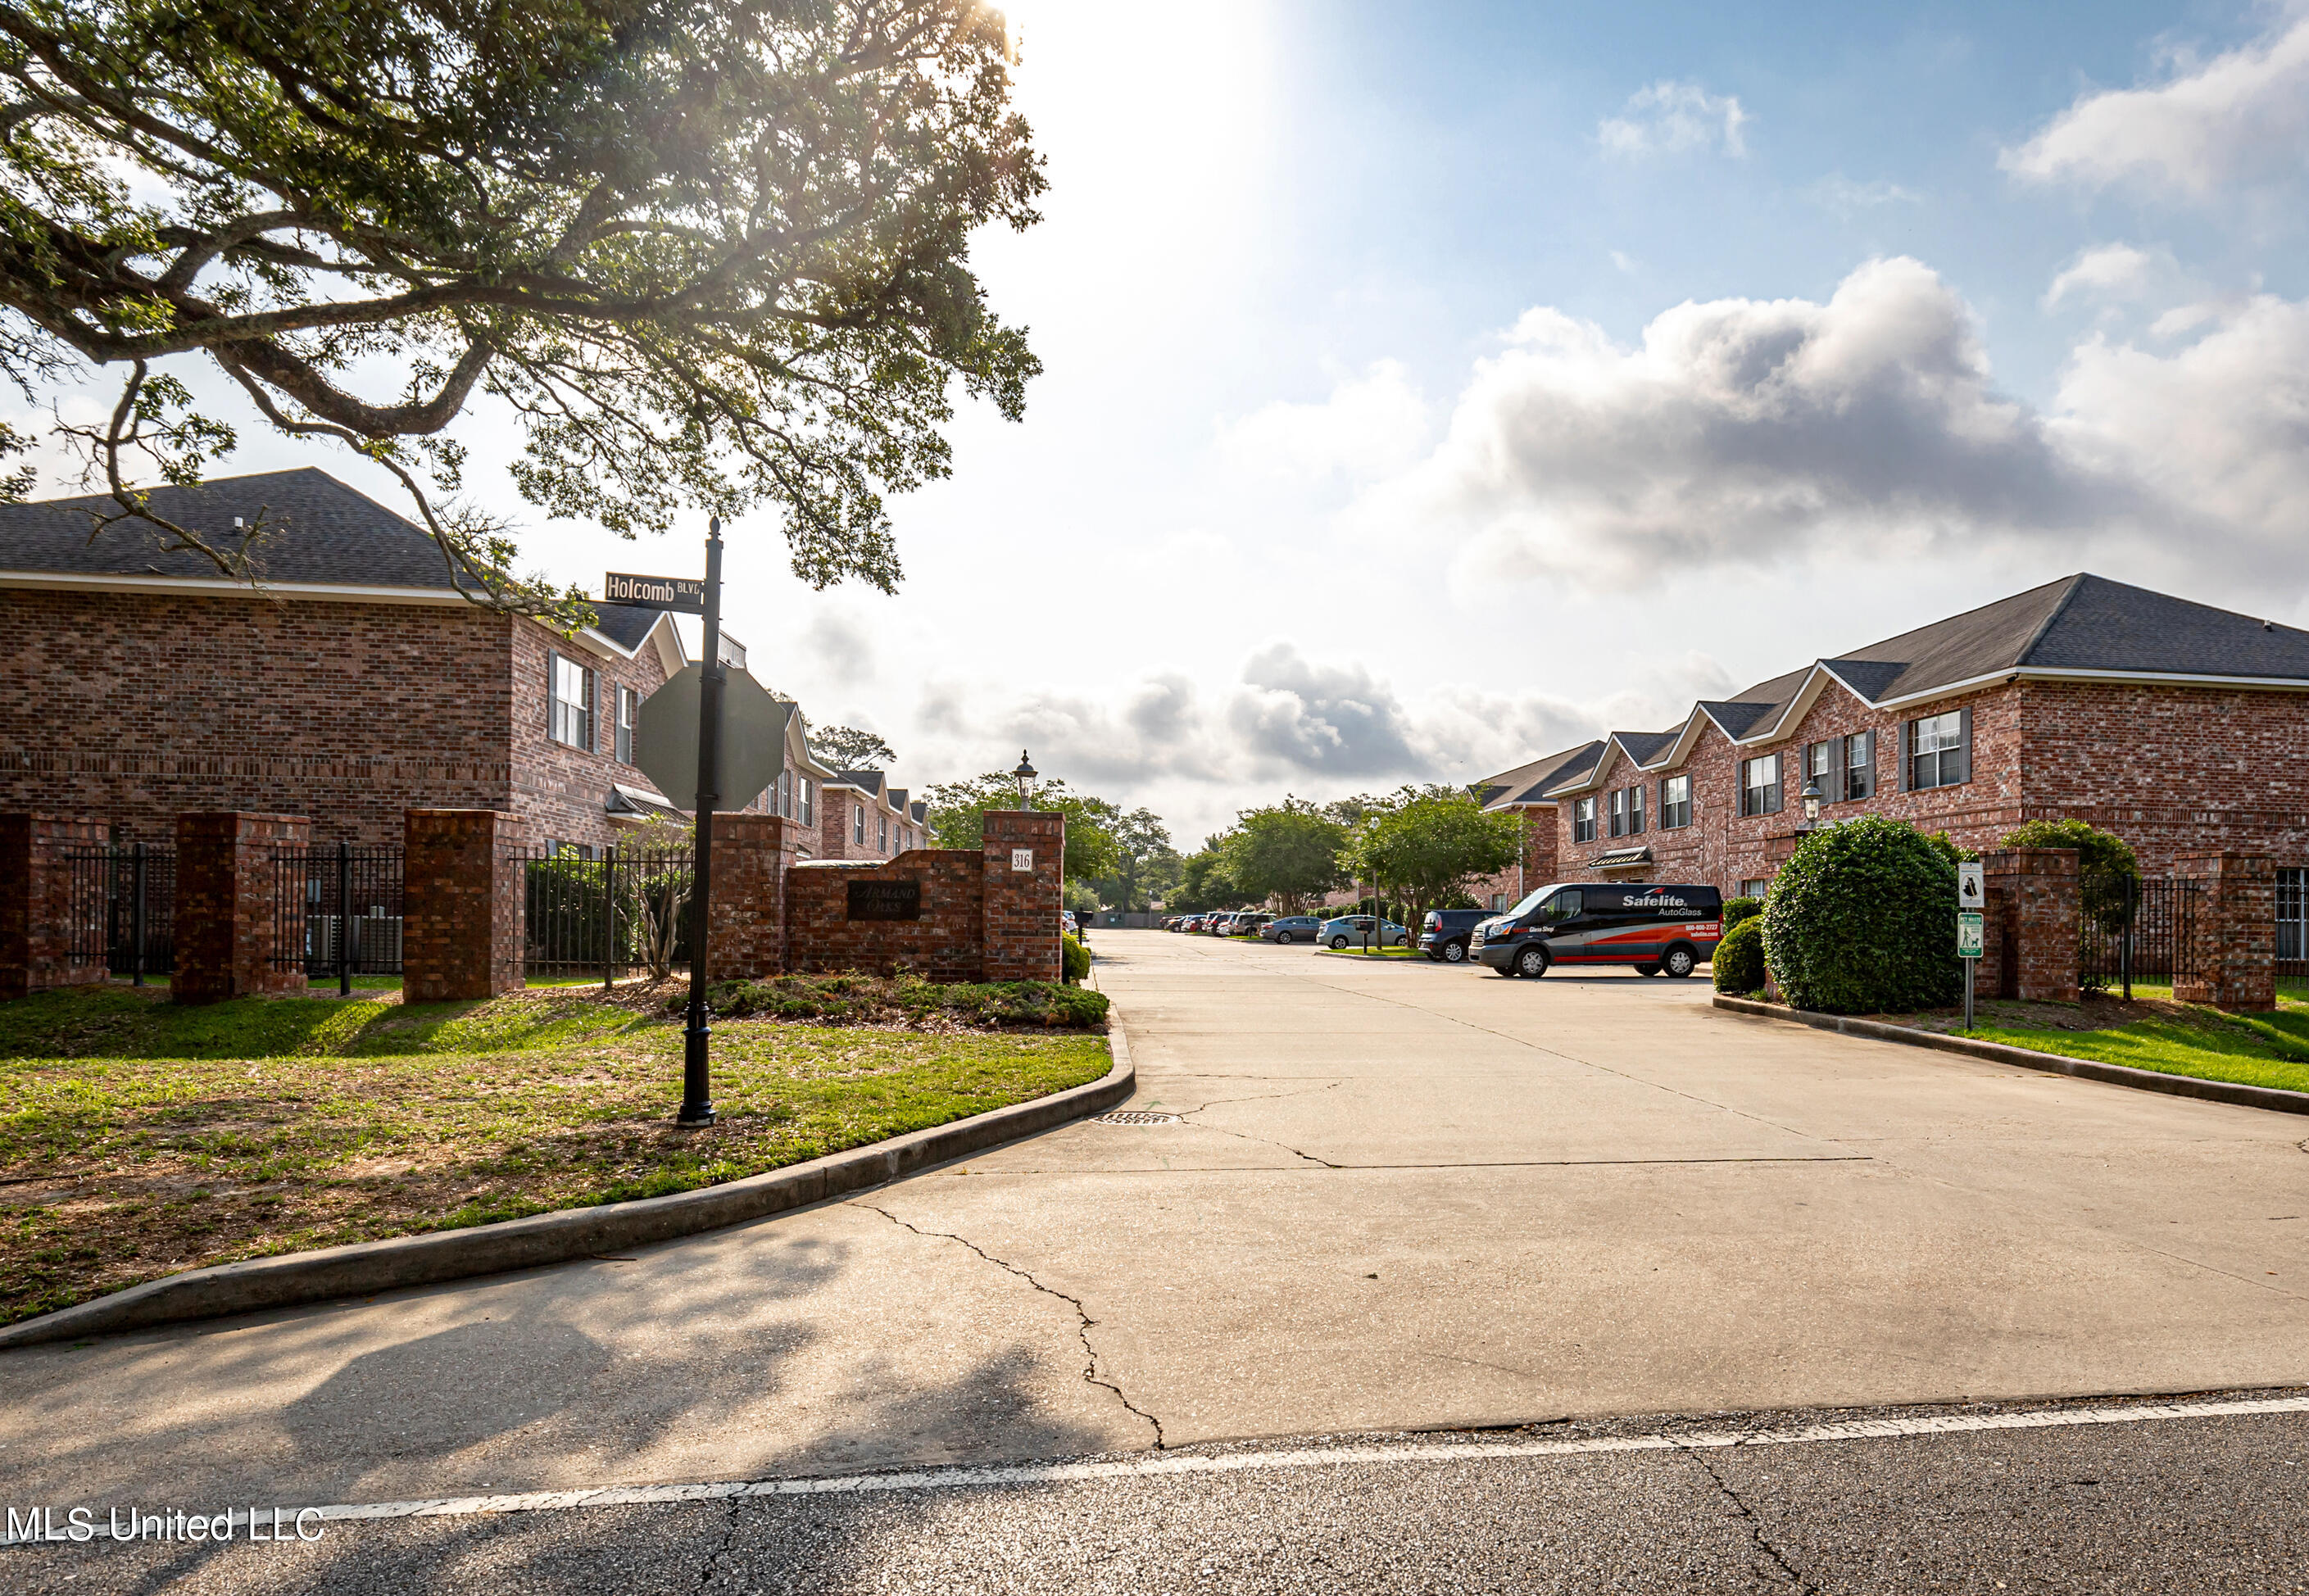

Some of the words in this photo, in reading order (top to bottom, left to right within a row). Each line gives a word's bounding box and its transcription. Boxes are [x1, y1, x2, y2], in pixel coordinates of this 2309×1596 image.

[608, 576, 674, 602] Holcomb
[1014, 854, 1030, 868] 316
[1622, 895, 1685, 906] Safelite
[1658, 908, 1702, 916] AutoGlass
